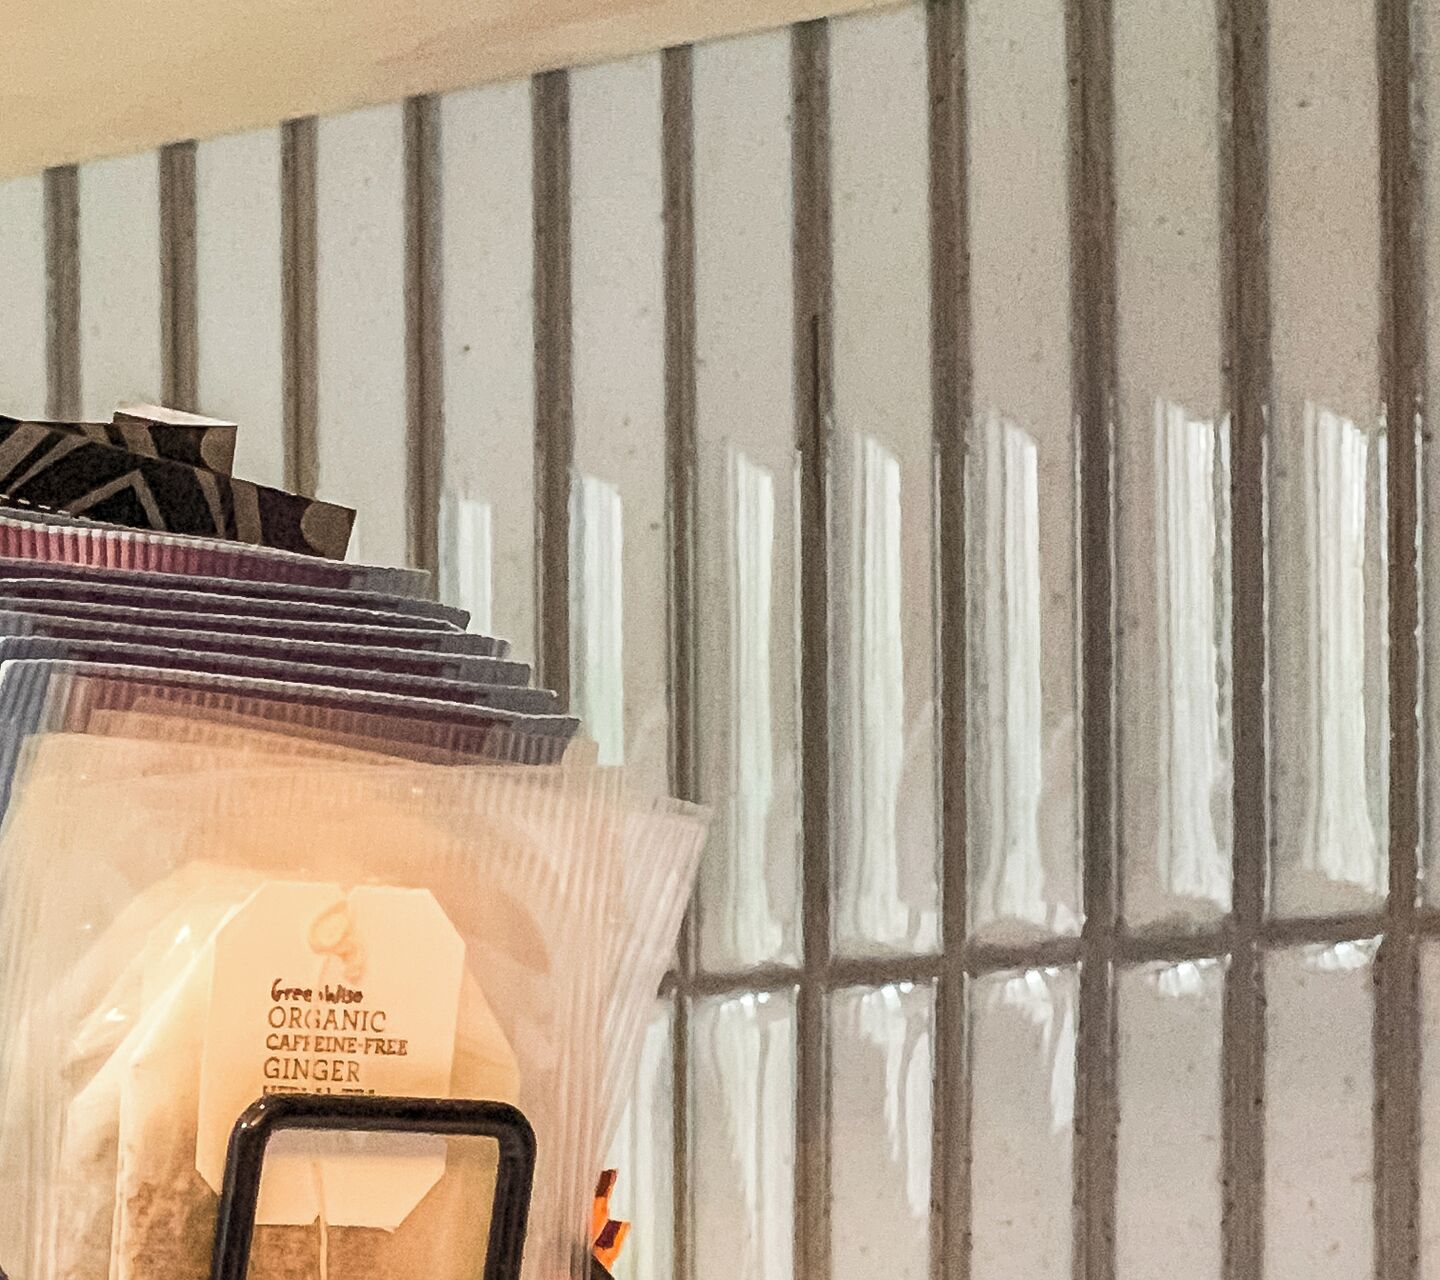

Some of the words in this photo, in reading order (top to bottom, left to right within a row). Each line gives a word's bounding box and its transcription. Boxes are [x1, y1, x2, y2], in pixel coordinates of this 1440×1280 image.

[267, 1005, 387, 1033] ORGANIC
[265, 1033, 409, 1056] CAFFEINE-FREE
[263, 1056, 361, 1082] GINGER
